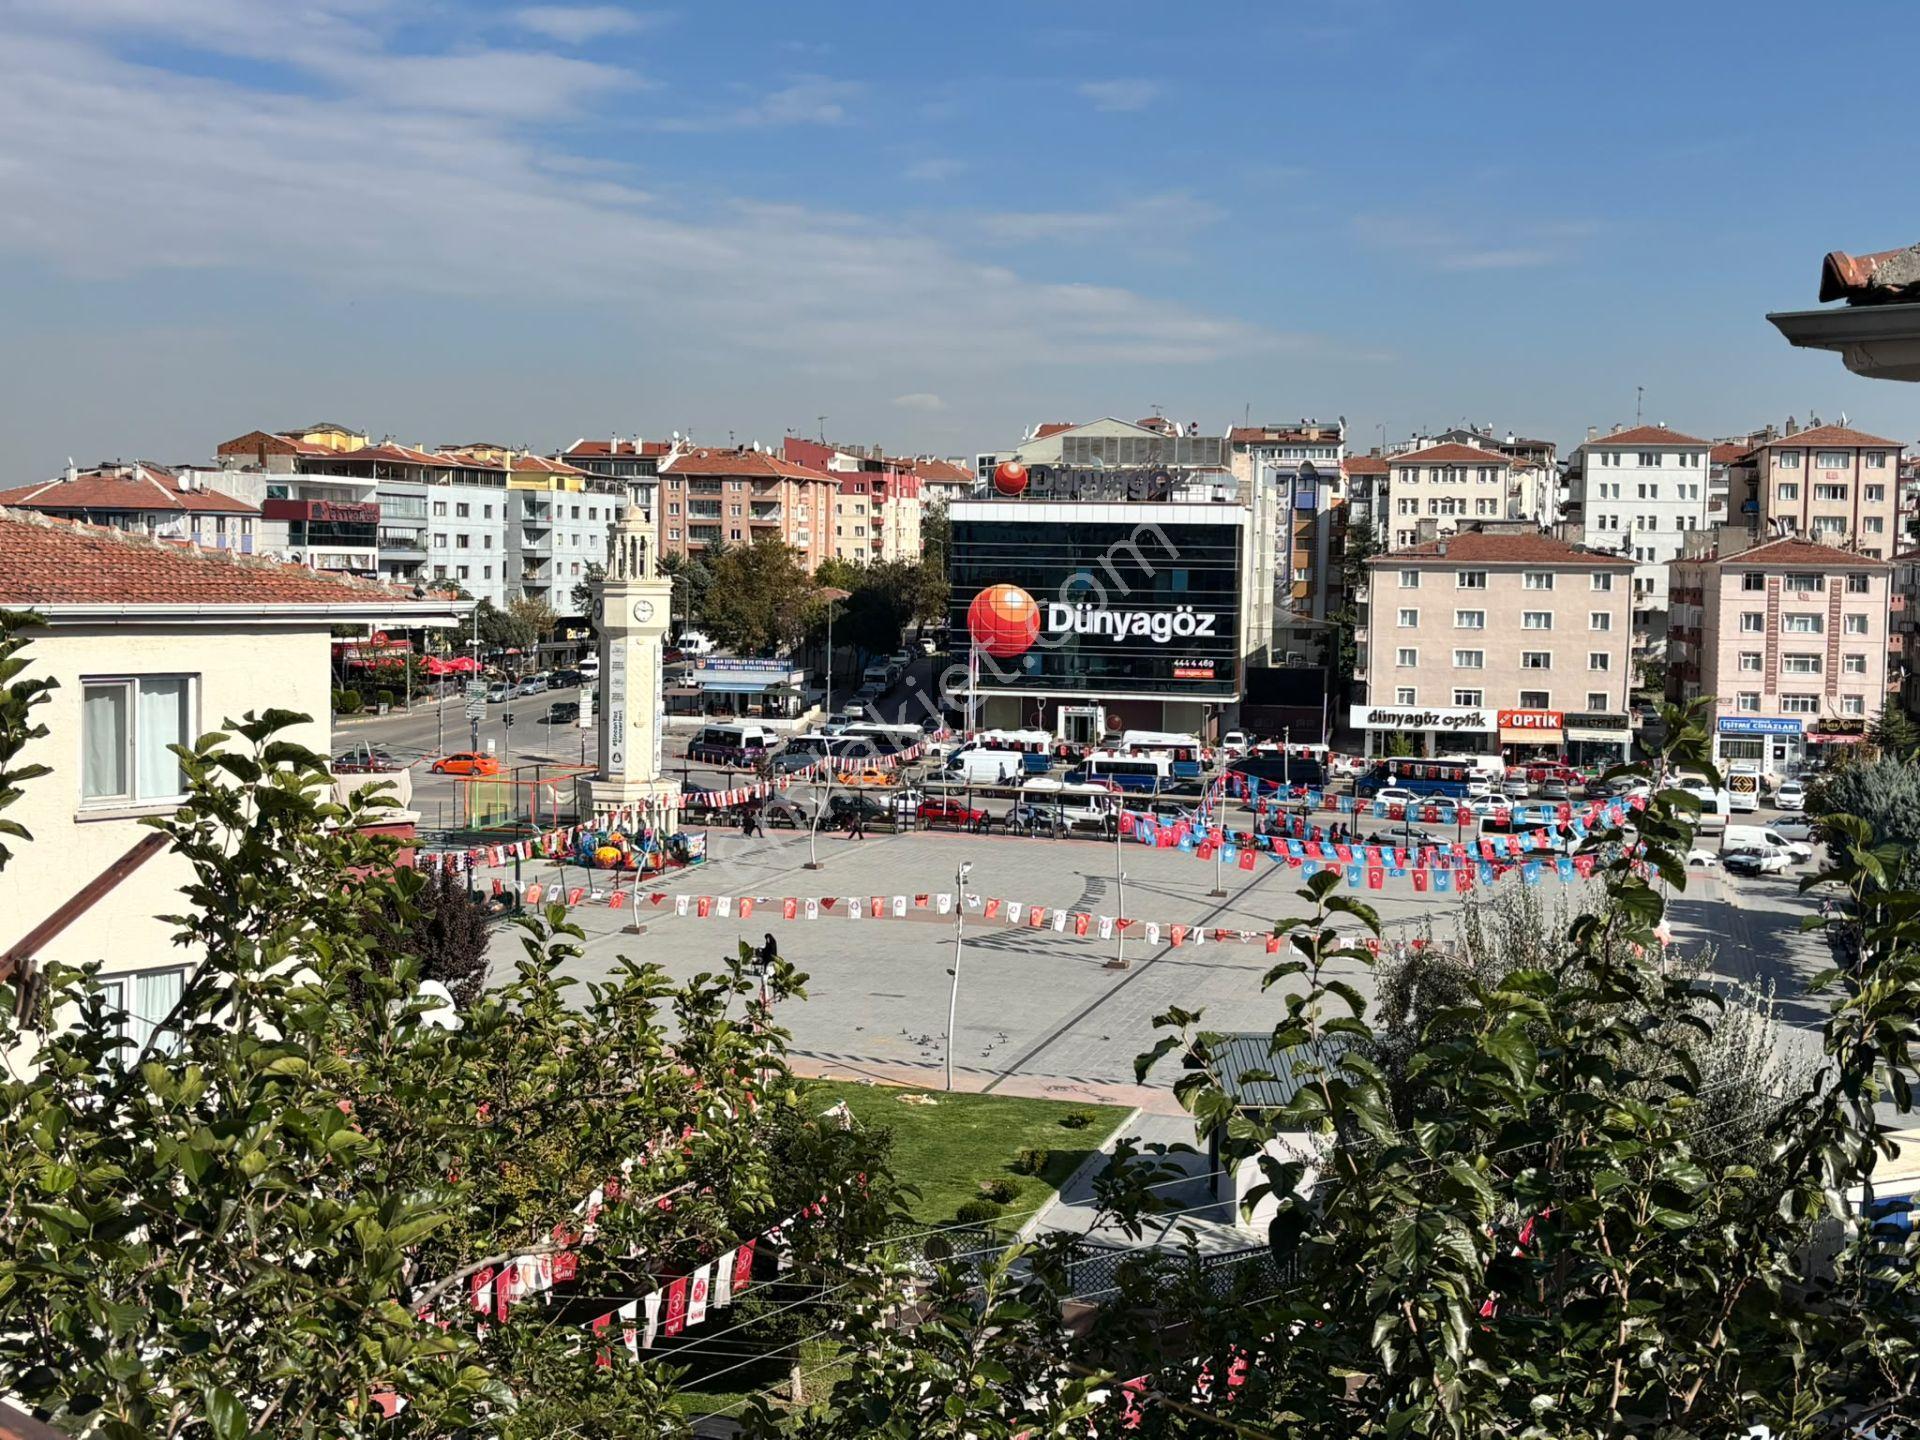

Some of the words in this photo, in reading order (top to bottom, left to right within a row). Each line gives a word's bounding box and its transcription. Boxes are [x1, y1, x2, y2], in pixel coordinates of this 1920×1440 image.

[1030, 463, 1190, 499] Dünyagöz
[1048, 603, 1216, 643] Dünyagöz
[1367, 709, 1440, 727] dünyagöz
[1442, 711, 1486, 730] optik
[1512, 712, 1560, 728] OPTİK
